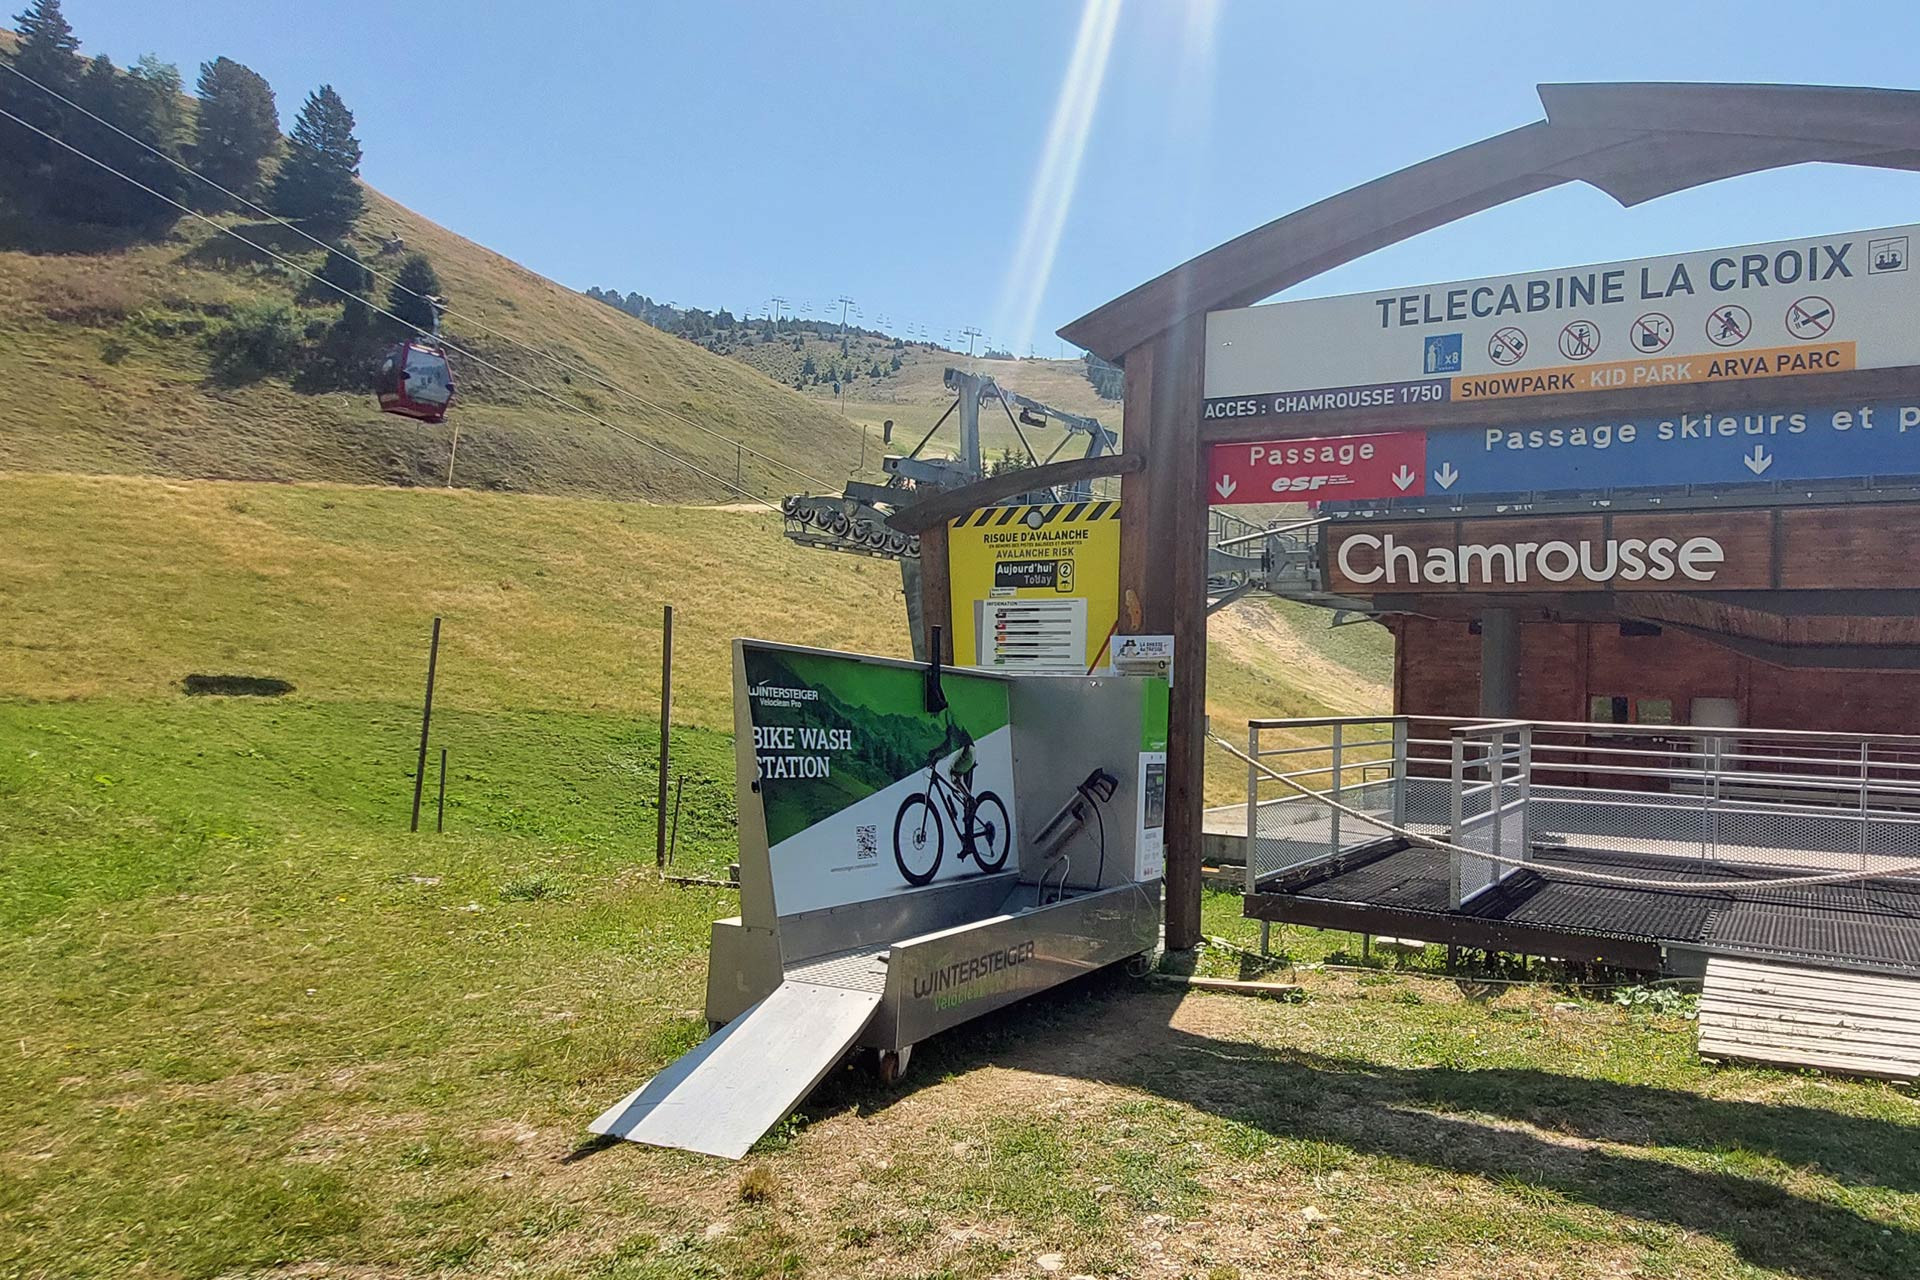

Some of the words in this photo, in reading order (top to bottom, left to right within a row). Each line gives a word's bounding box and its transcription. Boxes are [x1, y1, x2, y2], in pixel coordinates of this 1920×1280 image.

[1376, 270, 1625, 328] TELECABINE
[1640, 263, 1695, 300] LA
[1709, 242, 1854, 291] CROIX
[1445, 351, 1459, 364] x8
[1461, 372, 1576, 398] SNOWPARK
[1590, 368, 1627, 388] KID
[1633, 362, 1693, 383] PARK
[1707, 356, 1769, 378] ARVA
[1776, 350, 1841, 373] PARC
[1274, 388, 1396, 414] CHAMROUSSE
[1400, 384, 1443, 404] 1750
[1485, 423, 1637, 450] Passage
[1657, 411, 1808, 440] skieurs
[1831, 406, 1874, 430] et
[1249, 442, 1375, 467] Passage
[984, 532, 1018, 543] RISQUE
[1021, 530, 1088, 542] D'AVALANCHE
[996, 547, 1050, 559] AVALANCHE
[1052, 546, 1075, 557] RISK
[1337, 533, 1725, 584] Chamrousse
[997, 563, 1052, 575] Aujourd'hui
[1062, 565, 1069, 575] 2
[1024, 575, 1052, 585] Today
[748, 685, 819, 701] WINTERSTEIGER
[753, 726, 795, 749] BIKE
[799, 727, 853, 750] WASH
[914, 941, 1034, 998] WINTERSTEIGER
